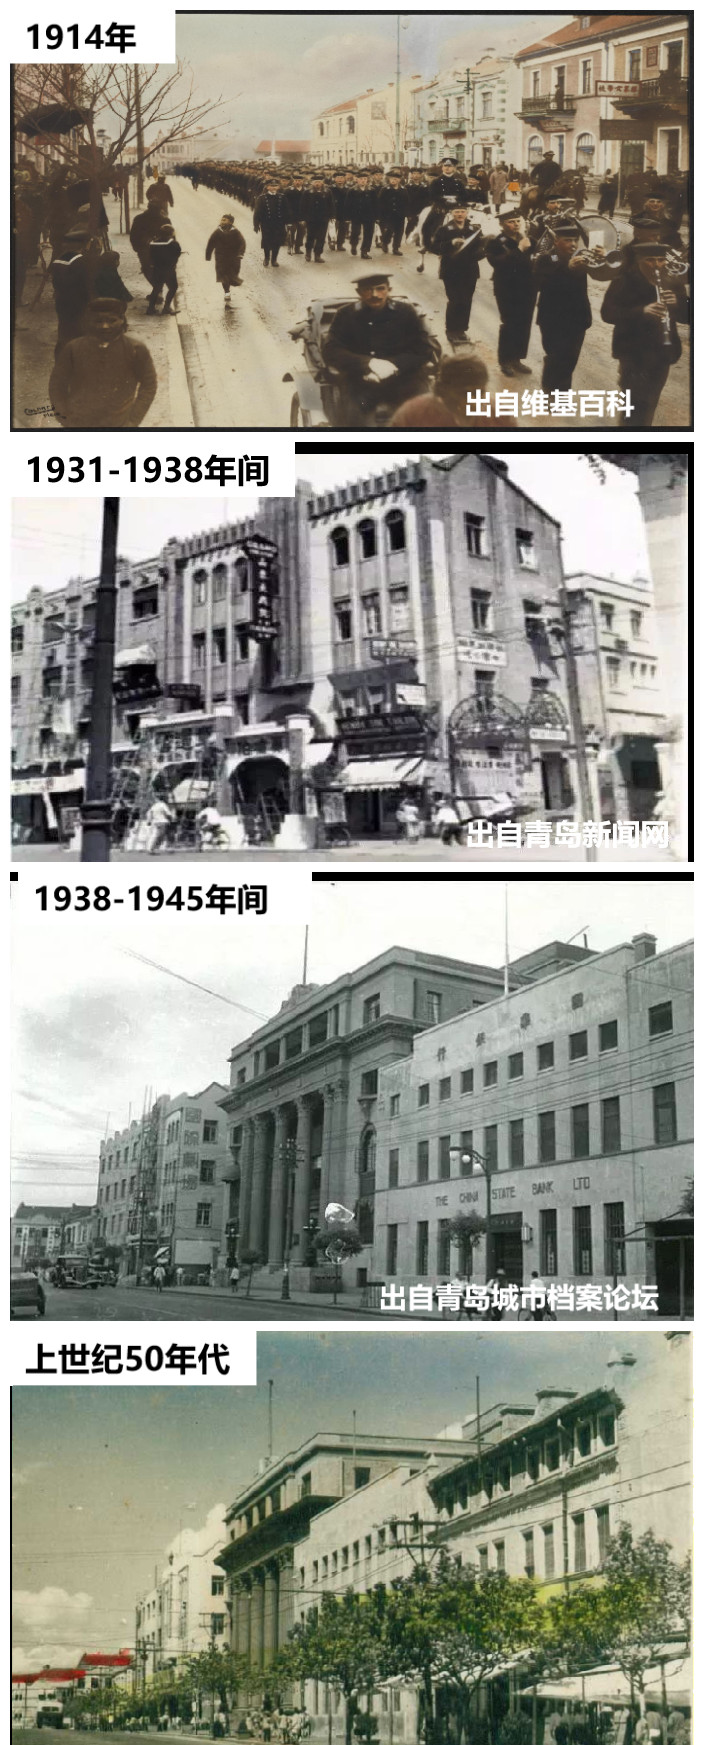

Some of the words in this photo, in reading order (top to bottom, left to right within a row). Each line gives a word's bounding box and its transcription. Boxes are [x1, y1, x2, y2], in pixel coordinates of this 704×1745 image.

[435, 1195, 448, 1207] THE
[459, 1191, 479, 1204] CHINA
[491, 1186, 516, 1200] STATE
[532, 1181, 555, 1195] BANK
[573, 1176, 590, 1191] LTD
